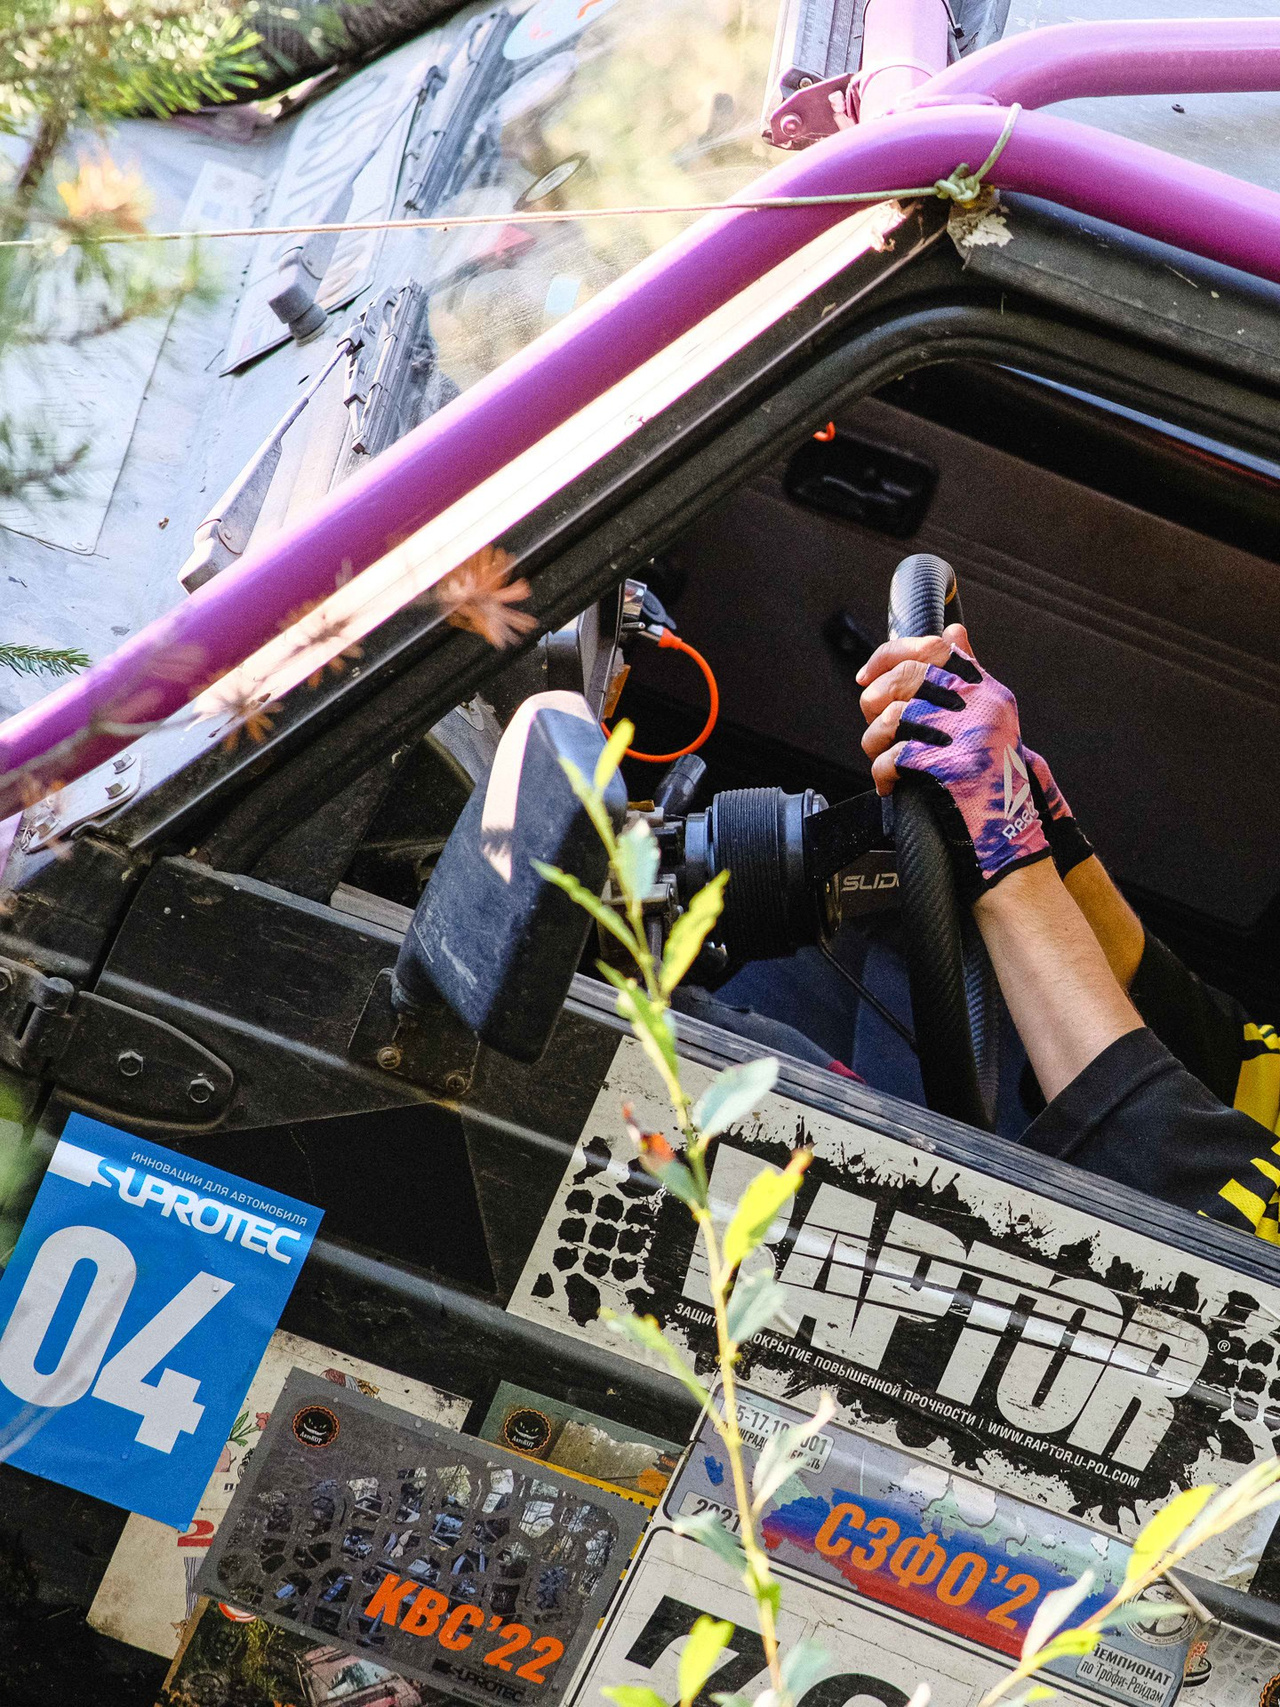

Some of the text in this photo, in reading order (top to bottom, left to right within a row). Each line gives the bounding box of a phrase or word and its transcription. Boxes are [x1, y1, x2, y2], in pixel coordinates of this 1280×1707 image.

[840, 872, 899, 892] SLID
[97, 1156, 301, 1265] SUPROTEC
[131, 1152, 308, 1227] ИННОВАЦИИ ДЛЯ АВТОМОБИЛЯ
[0, 1225, 236, 1455] 04
[682, 1142, 1210, 1472] RAPTOR
[751, 1331, 813, 1366] ОКРЫТИЕ
[813, 1353, 902, 1396] ПОВЫШЕННОЙ
[903, 1389, 977, 1428] ПРОЧНОСТИ
[987, 1422, 1141, 1489] WWW.RAPTOR.U-POL.COM
[1080, 1660, 1165, 1704] по Трофи-Рейдам
